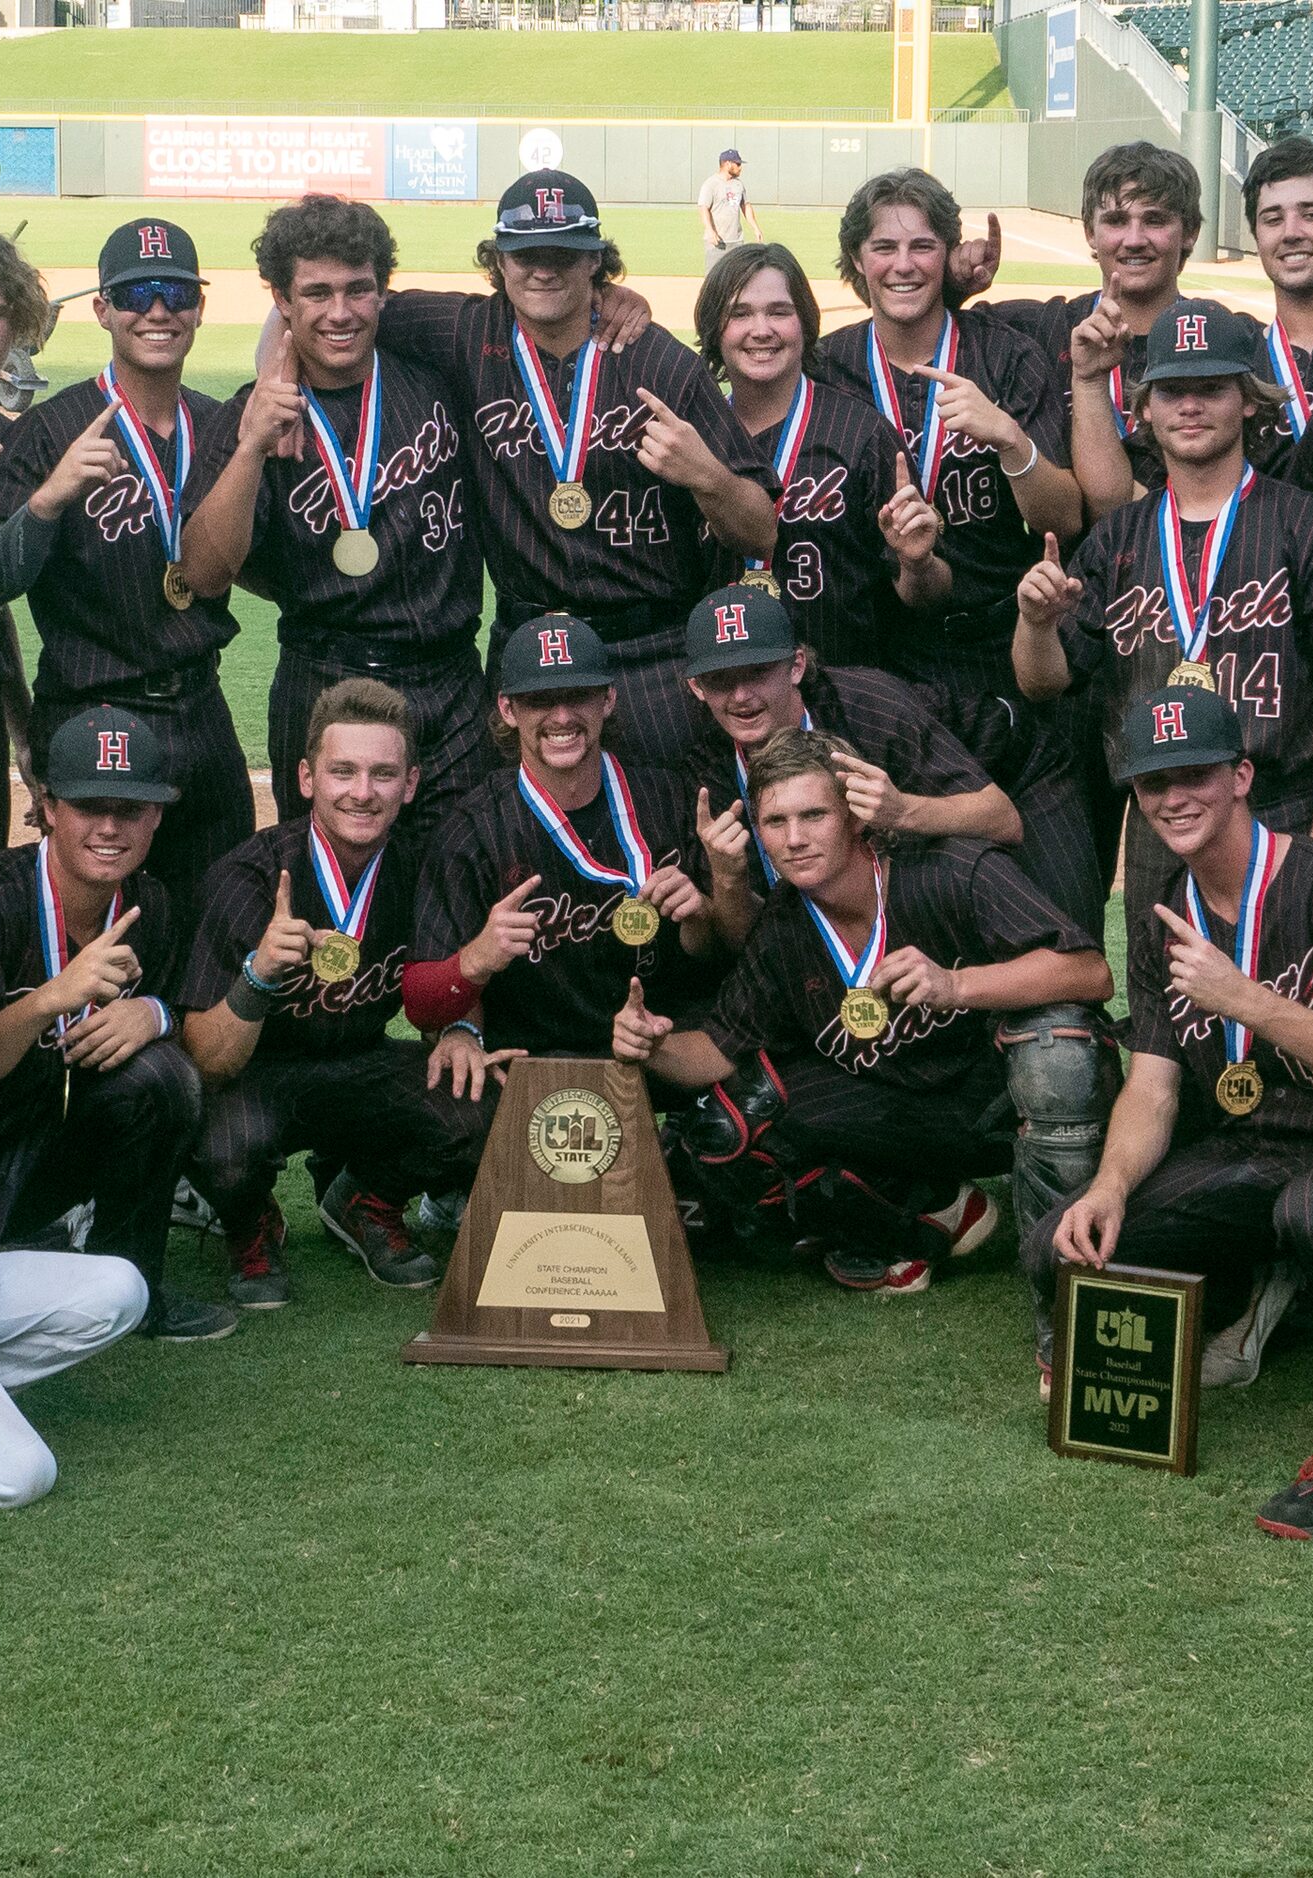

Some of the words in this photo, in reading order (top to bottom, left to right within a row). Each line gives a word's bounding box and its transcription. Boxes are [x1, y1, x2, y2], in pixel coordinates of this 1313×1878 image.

[149, 131, 214, 147] CARING
[219, 131, 253, 147] FOR
[256, 131, 307, 147] YOUR
[829, 138, 860, 152] 325
[148, 148, 233, 174] CLOSE
[238, 149, 276, 174] TO
[280, 149, 372, 175] HOME.
[408, 159, 465, 174] HOSPITAL
[530, 144, 552, 165] 42
[535, 187, 566, 224] H
[138, 225, 173, 260] H
[1174, 314, 1209, 352] H
[942, 465, 999, 526] 18
[594, 485, 670, 546] 44
[786, 541, 824, 601] 3
[714, 603, 749, 643] H
[538, 629, 574, 667] H
[1215, 651, 1282, 719] 14
[1151, 701, 1189, 745] H
[96, 731, 131, 771] H
[621, 911, 651, 931] UIL
[847, 1001, 881, 1022] UIL
[1225, 1076, 1256, 1100] UIL
[544, 1108, 604, 1151] UIL
[554, 1151, 592, 1163] STATE
[505, 1231, 544, 1271] UNIVERSITY
[543, 1222, 615, 1247] INTERSCHOLASTIC
[536, 1264, 561, 1275] STATE
[562, 1265, 608, 1275] CHAMPION
[550, 1276, 593, 1286] BASEBALL
[524, 1285, 582, 1297] CONFERENCE
[558, 1315, 582, 1326] 2021
[1095, 1306, 1153, 1353] UIL
[1074, 1366, 1098, 1378] State
[1099, 1370, 1172, 1391] Championships
[1105, 1356, 1142, 1372] Baseball
[1083, 1386, 1159, 1420] MVP
